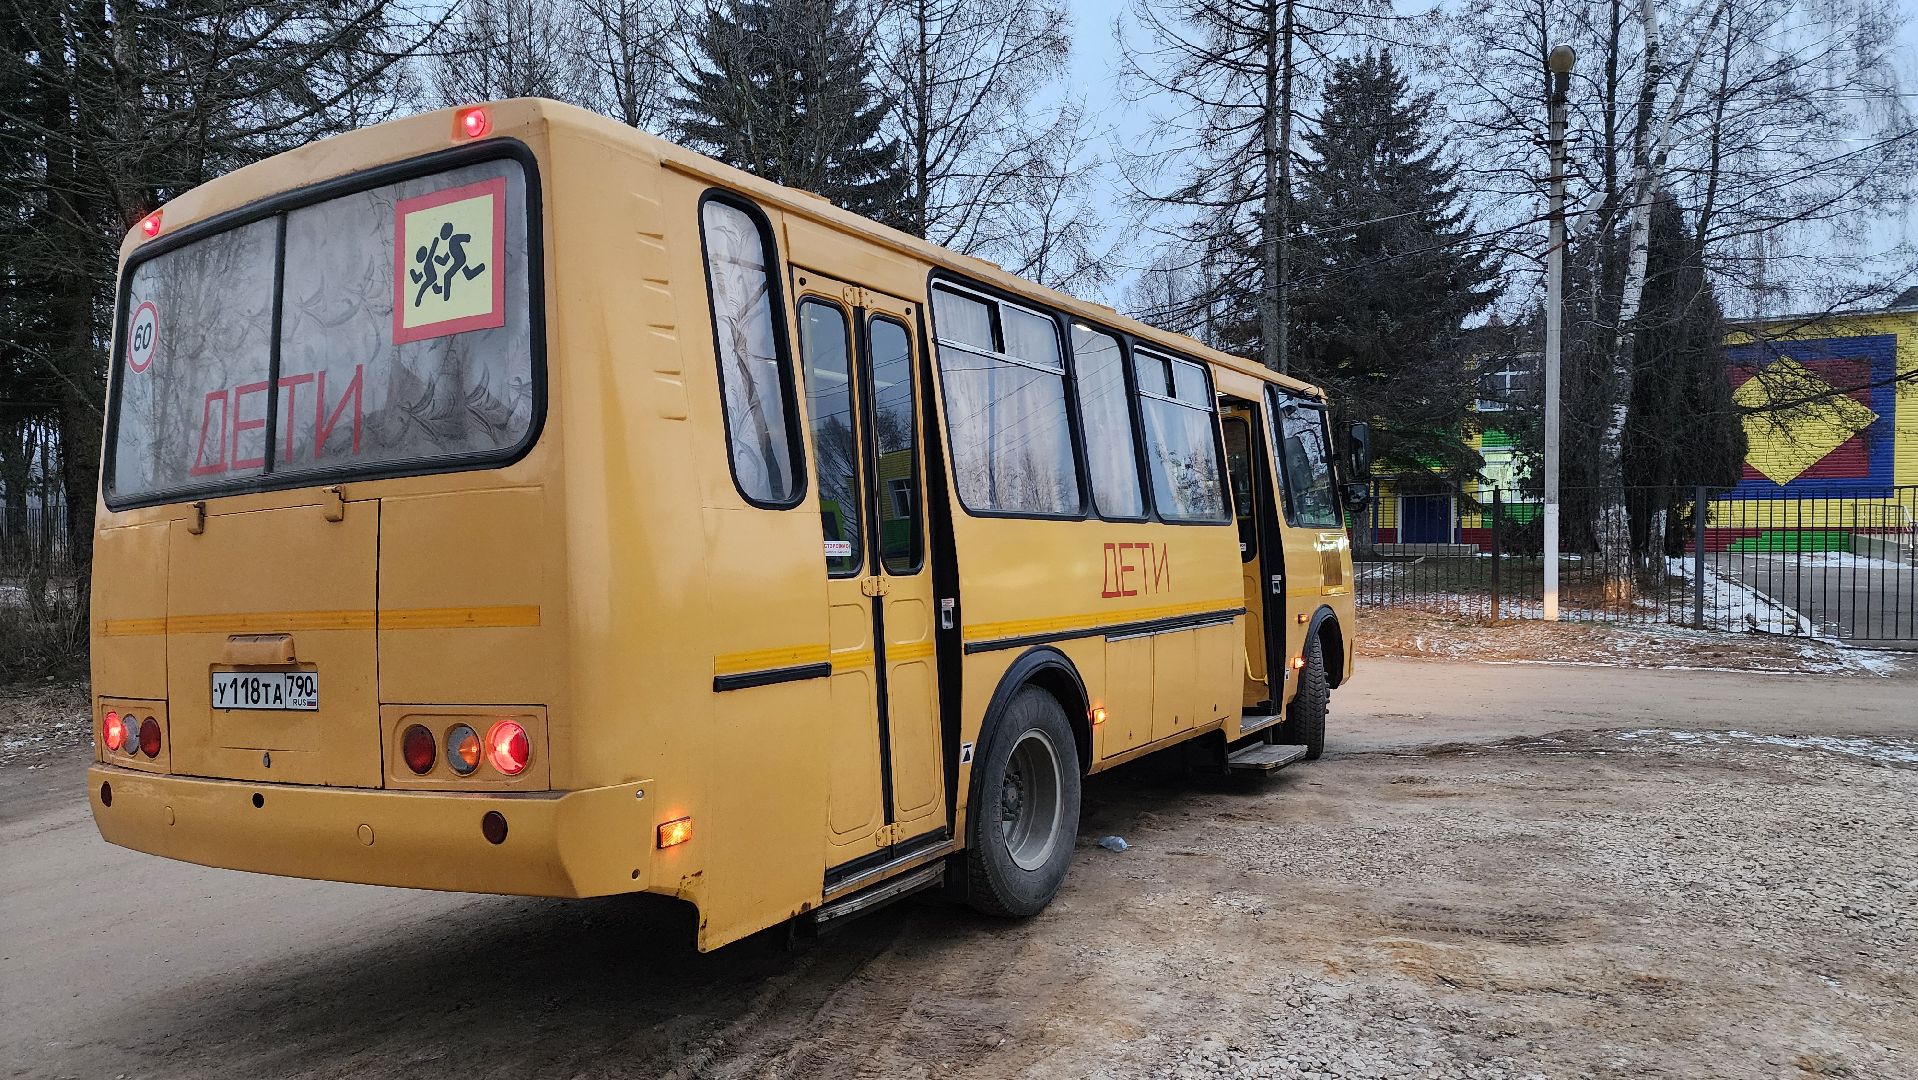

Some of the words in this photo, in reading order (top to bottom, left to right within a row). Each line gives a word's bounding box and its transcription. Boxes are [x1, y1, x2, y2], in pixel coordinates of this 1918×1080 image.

[134, 322, 152, 352] 60
[190, 363, 364, 477] ДЕТИ
[1101, 542, 1170, 599] ДЕТИ
[287, 675, 313, 697] 790
